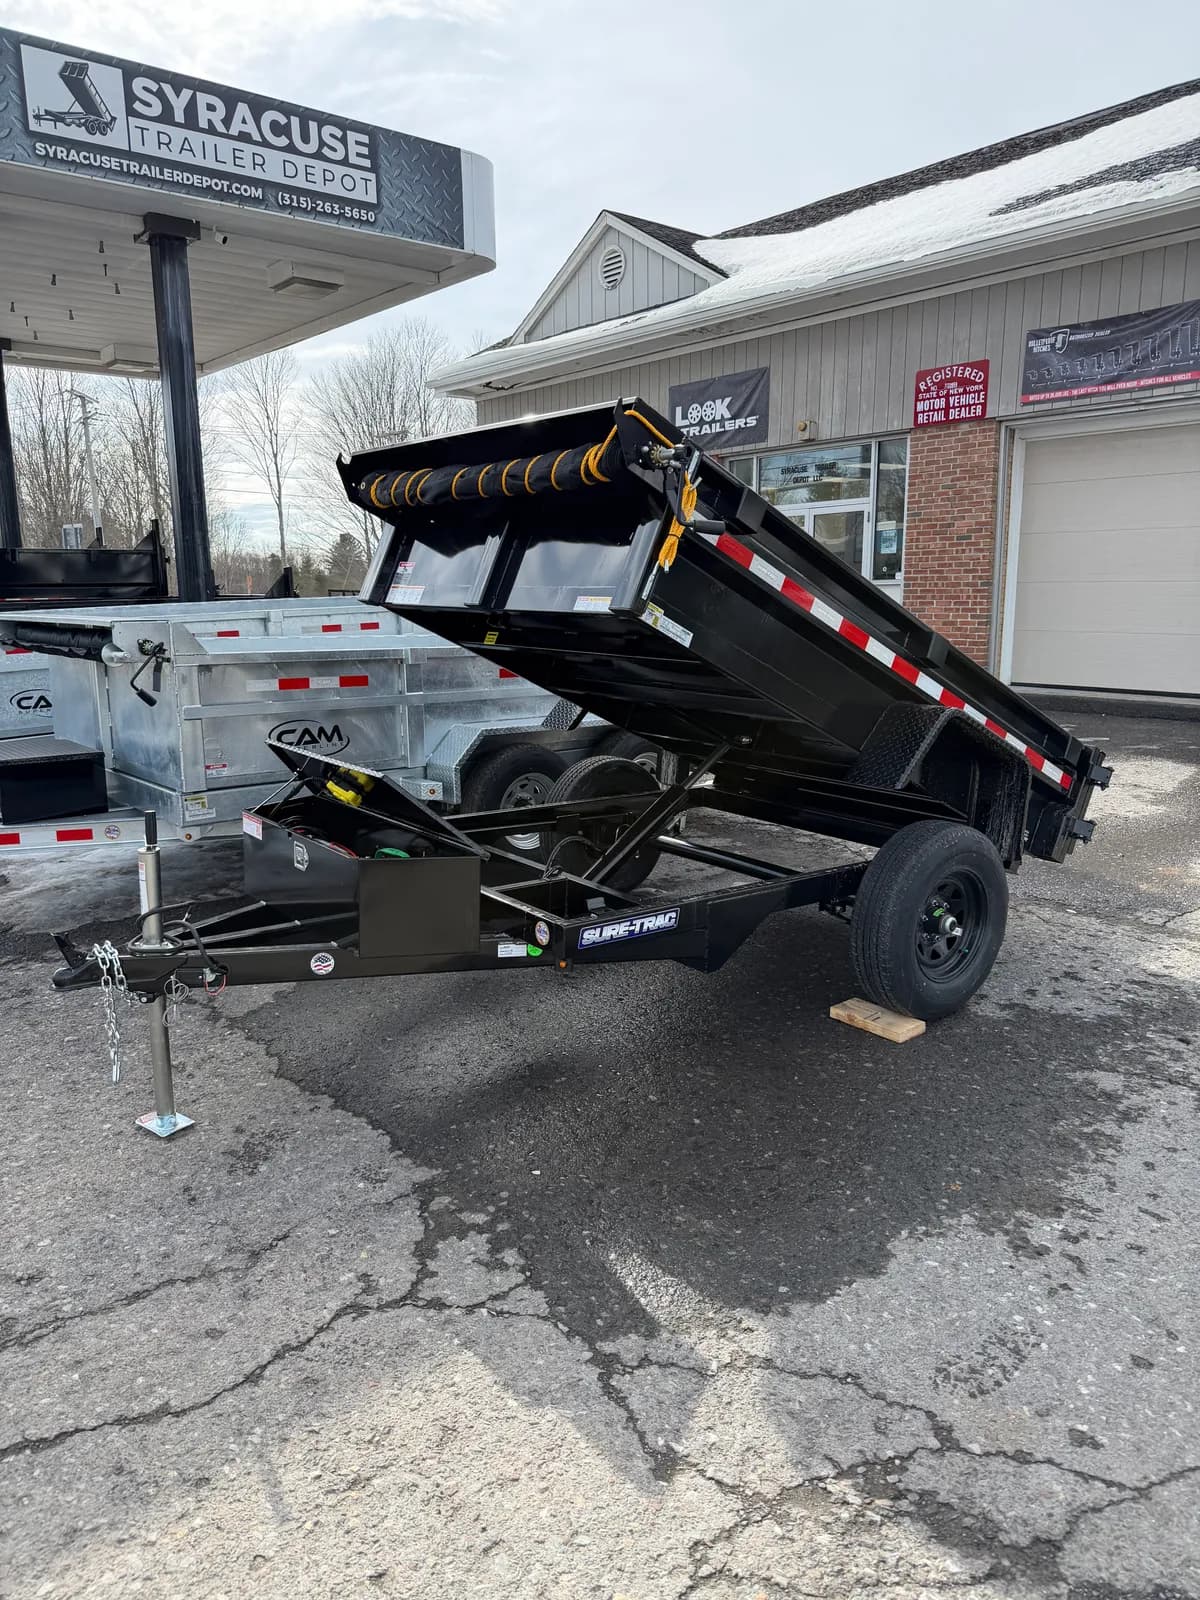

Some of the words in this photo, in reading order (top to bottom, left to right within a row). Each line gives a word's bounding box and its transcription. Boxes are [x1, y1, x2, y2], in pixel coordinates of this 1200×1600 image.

[131, 76, 371, 168] SYRACUSE
[35, 142, 263, 200] SYRACUSETRAILERDEPOT.COM
[134, 125, 266, 173] TRAILER
[283, 159, 372, 196] DEPOT
[278, 191, 376, 223] (315)-263-5650
[919, 366, 985, 392] REGISTERED
[919, 391, 937, 399] STATE
[949, 386, 964, 394] NEW
[966, 384, 984, 392] YORK
[675, 396, 732, 427] LOOK
[917, 397, 946, 412] MOTOR
[949, 391, 985, 407] VEHICLE
[917, 410, 947, 424] RETAIL
[949, 405, 982, 420] DEALER
[680, 416, 757, 437] TRAILERS
[16, 695, 53, 710] CA
[276, 724, 344, 747] CAM
[580, 911, 677, 945] SURE-TRAC
